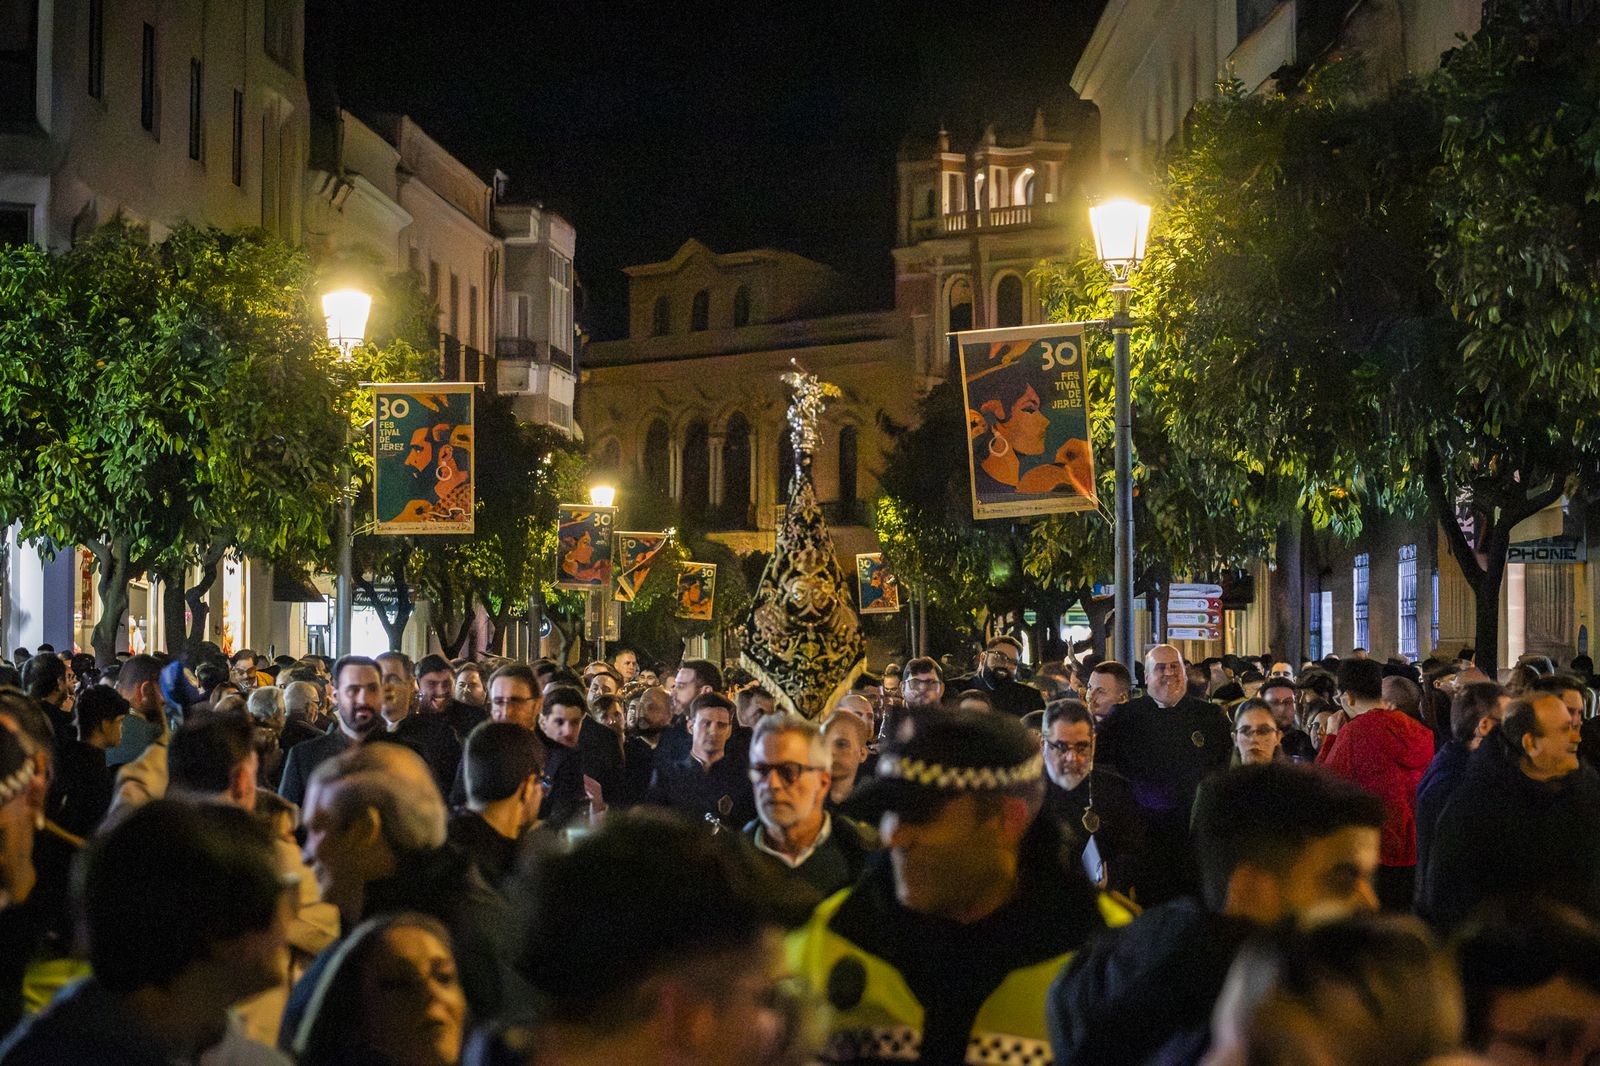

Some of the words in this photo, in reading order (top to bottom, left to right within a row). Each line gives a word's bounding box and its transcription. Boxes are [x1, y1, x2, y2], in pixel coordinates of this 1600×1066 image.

[1040, 342, 1077, 371] 30
[1061, 371, 1080, 381] FES
[1055, 380, 1080, 391] TIVAL
[1068, 390, 1081, 399] DE
[379, 397, 409, 420] 30
[1052, 399, 1082, 409] JEREZ
[379, 421, 395, 429] FES
[379, 428, 401, 437] TIVAL
[379, 436, 391, 444] DE
[379, 443, 405, 451] JEREZ
[593, 512, 611, 527] 30
[1508, 547, 1577, 560] PHONE
[701, 567, 714, 578] 30
